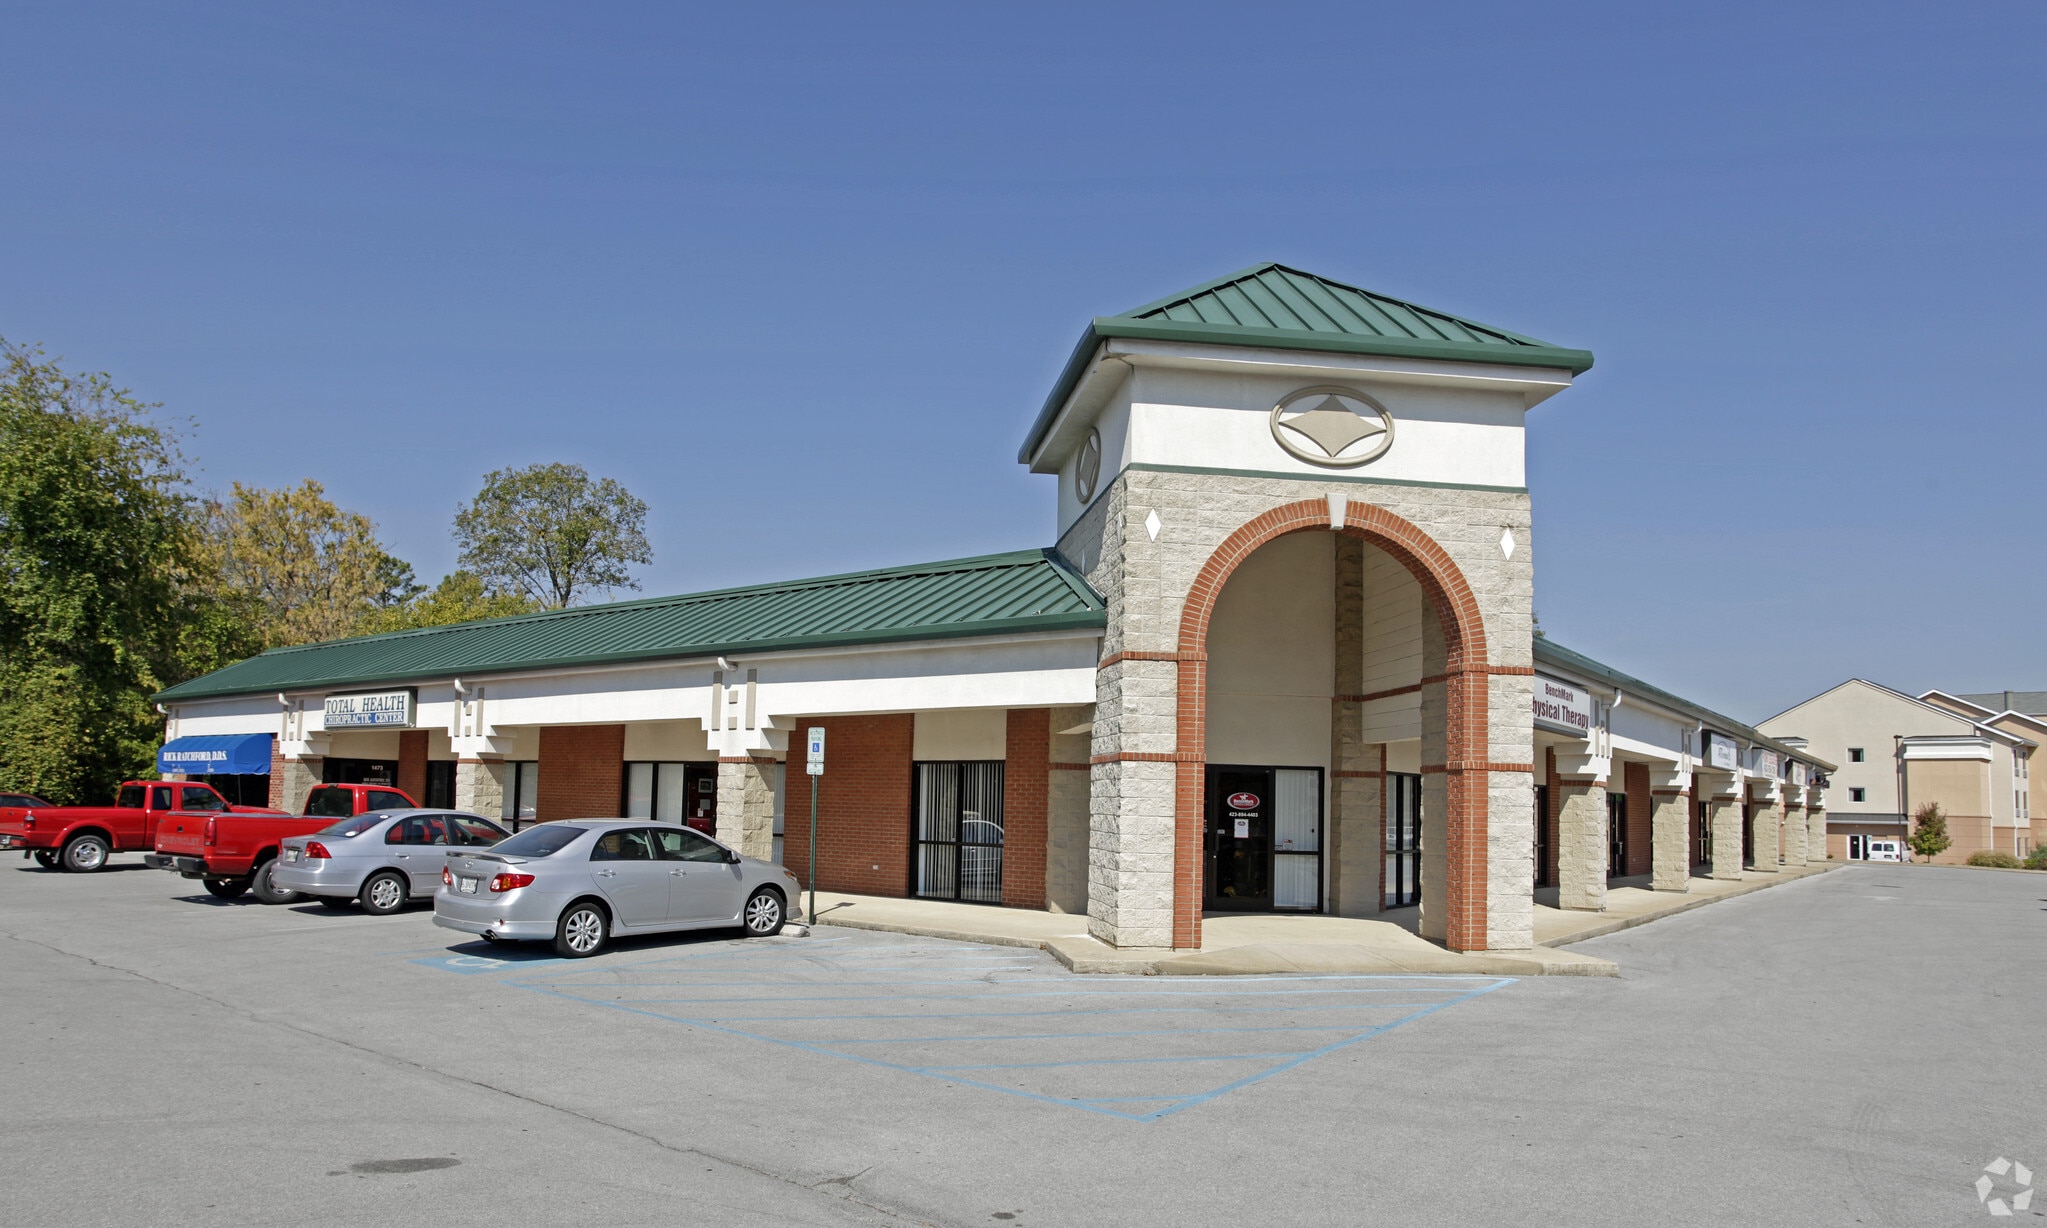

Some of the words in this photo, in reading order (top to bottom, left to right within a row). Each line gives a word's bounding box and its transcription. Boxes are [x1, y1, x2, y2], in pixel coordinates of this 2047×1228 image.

[1545, 683, 1574, 703] BenchMark
[326, 699, 355, 714] TOTAL
[362, 695, 405, 712] HEALTH
[1533, 696, 1560, 720] hysical
[1562, 705, 1589, 730] Therapy
[325, 713, 371, 725] CHIROPRACTIC
[375, 712, 403, 723] CENTER
[163, 751, 177, 762] RICK
